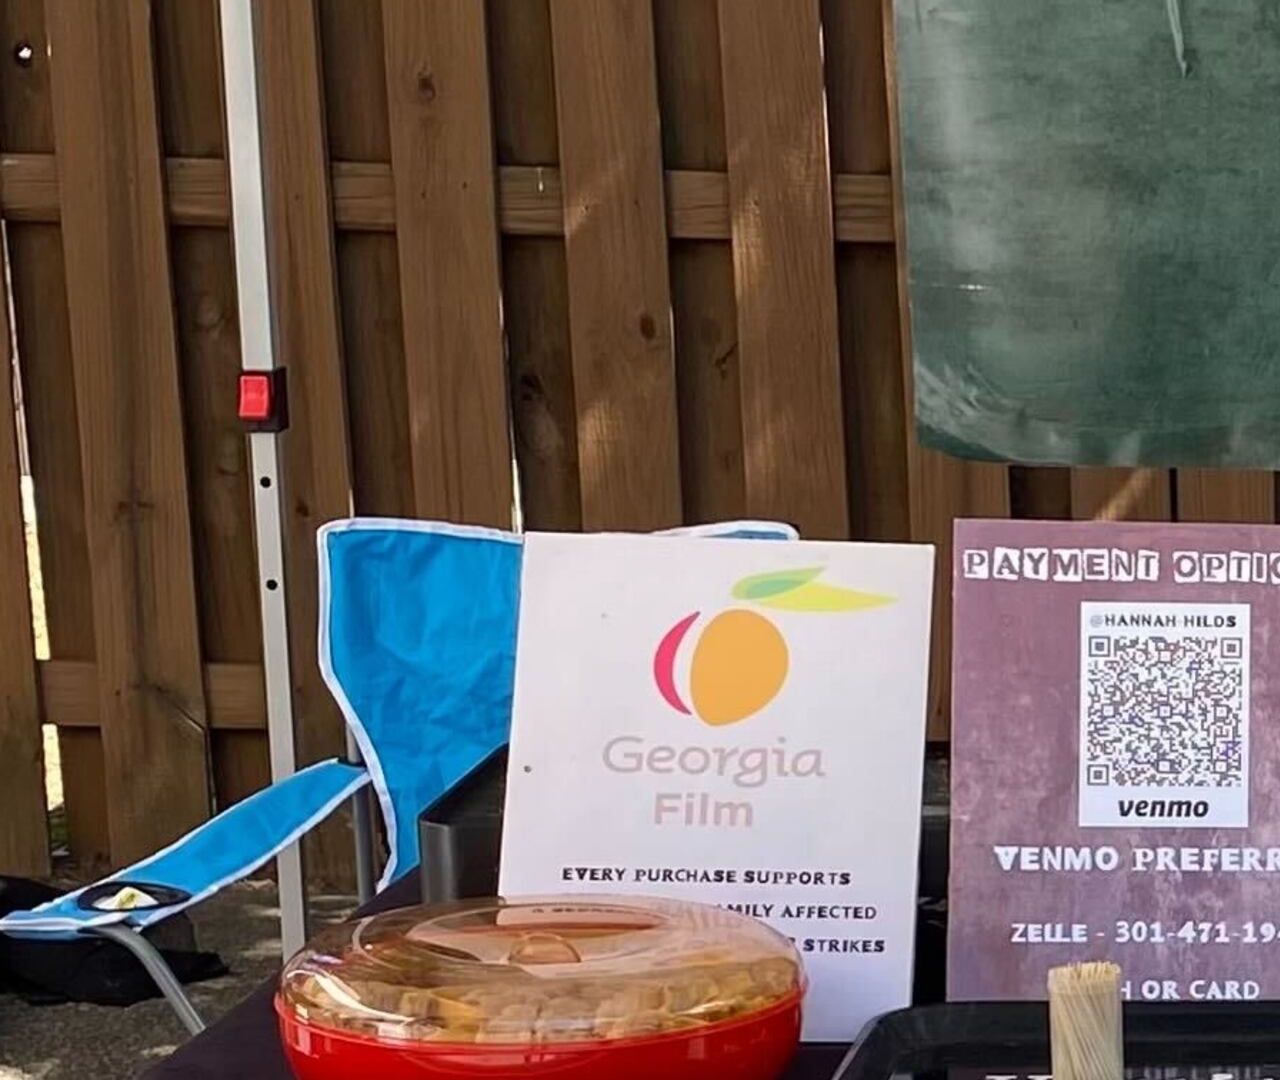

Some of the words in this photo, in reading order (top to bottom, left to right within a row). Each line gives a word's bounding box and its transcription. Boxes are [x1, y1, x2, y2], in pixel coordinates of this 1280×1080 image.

[965, 549, 1158, 581] PAYMENT
[1184, 614, 1236, 628] HILDS
[603, 736, 826, 788] Georgia
[654, 792, 753, 827] Film
[1118, 799, 1209, 819] venmo
[993, 846, 1119, 871] VENMO
[562, 867, 626, 882] EVERY
[635, 868, 738, 884] PURCHASE
[743, 869, 851, 886] SUPPORTS
[781, 905, 877, 920] AFFECTED
[1011, 922, 1088, 943] ZELLE
[803, 939, 885, 954] STRIKES
[1141, 980, 1180, 1000] OR
[1189, 980, 1260, 1000] CARD
